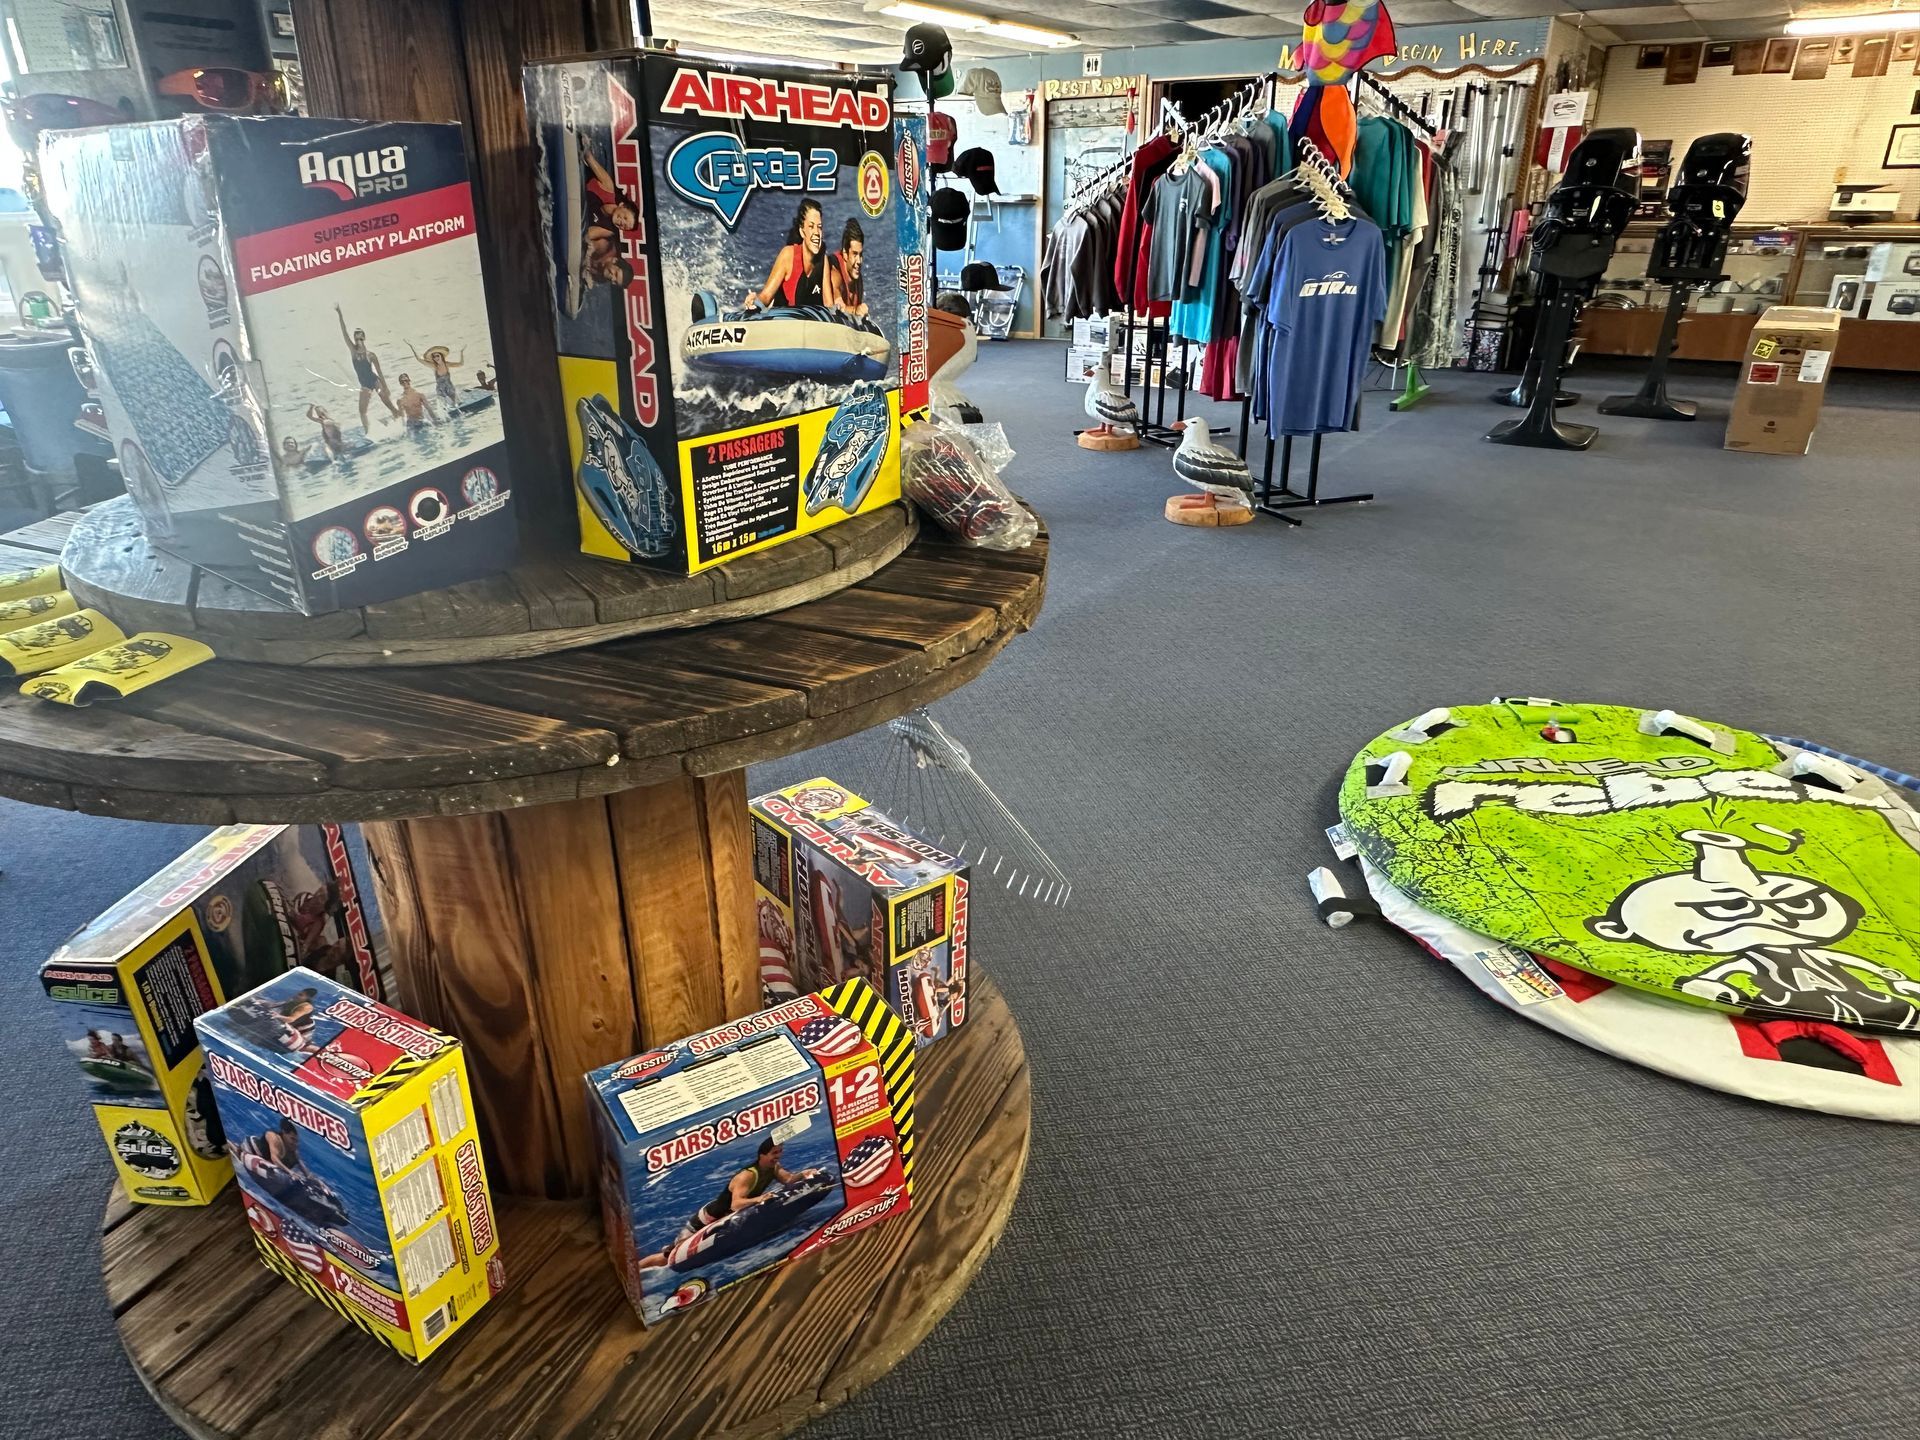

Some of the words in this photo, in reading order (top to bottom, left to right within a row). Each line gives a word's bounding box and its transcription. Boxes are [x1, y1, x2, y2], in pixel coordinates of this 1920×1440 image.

[661, 68, 890, 131] AIRHEAD
[298, 146, 406, 198] Aqua
[358, 174, 408, 198] PRO
[807, 148, 838, 191] 2
[904, 128, 914, 206] SPORTSSTUFF
[251, 249, 332, 282] FLOATING
[336, 233, 385, 261] PARTY
[389, 215, 465, 247] PLATFORM
[314, 213, 399, 244] SUPERSIZED
[606, 72, 659, 428] AIRHEAD
[908, 254, 923, 305] STARS
[909, 305, 924, 320] &
[687, 328, 746, 348] AIRHEAD
[910, 320, 924, 382] STRIPES
[707, 445, 715, 464] 2
[718, 430, 784, 461] PASSAGERS
[1438, 755, 1715, 778] AIRHEAD
[897, 968, 911, 1005] HOT
[326, 999, 372, 1032] STARS
[365, 1016, 388, 1038] &
[377, 1021, 444, 1058] STRIPES
[688, 1025, 741, 1055] STARS
[738, 1021, 755, 1037] &
[752, 999, 818, 1030] STRIPES
[318, 1051, 375, 1080] SPORTSSTUFF
[611, 1050, 679, 1081] SPORTSSTUFF
[830, 1065, 879, 1106] 1-2
[208, 1051, 260, 1101] STARS
[260, 1080, 278, 1112] &
[275, 1087, 351, 1150] STRIPES
[646, 1125, 716, 1173] STARS
[716, 1116, 738, 1145] &
[735, 1082, 820, 1137] STRIPES
[456, 1139, 481, 1191] STARS
[467, 1193, 494, 1255] STRIPES
[822, 1194, 900, 1239] SPORTSSTUFF
[320, 1227, 381, 1267] SPORTSSTUFF
